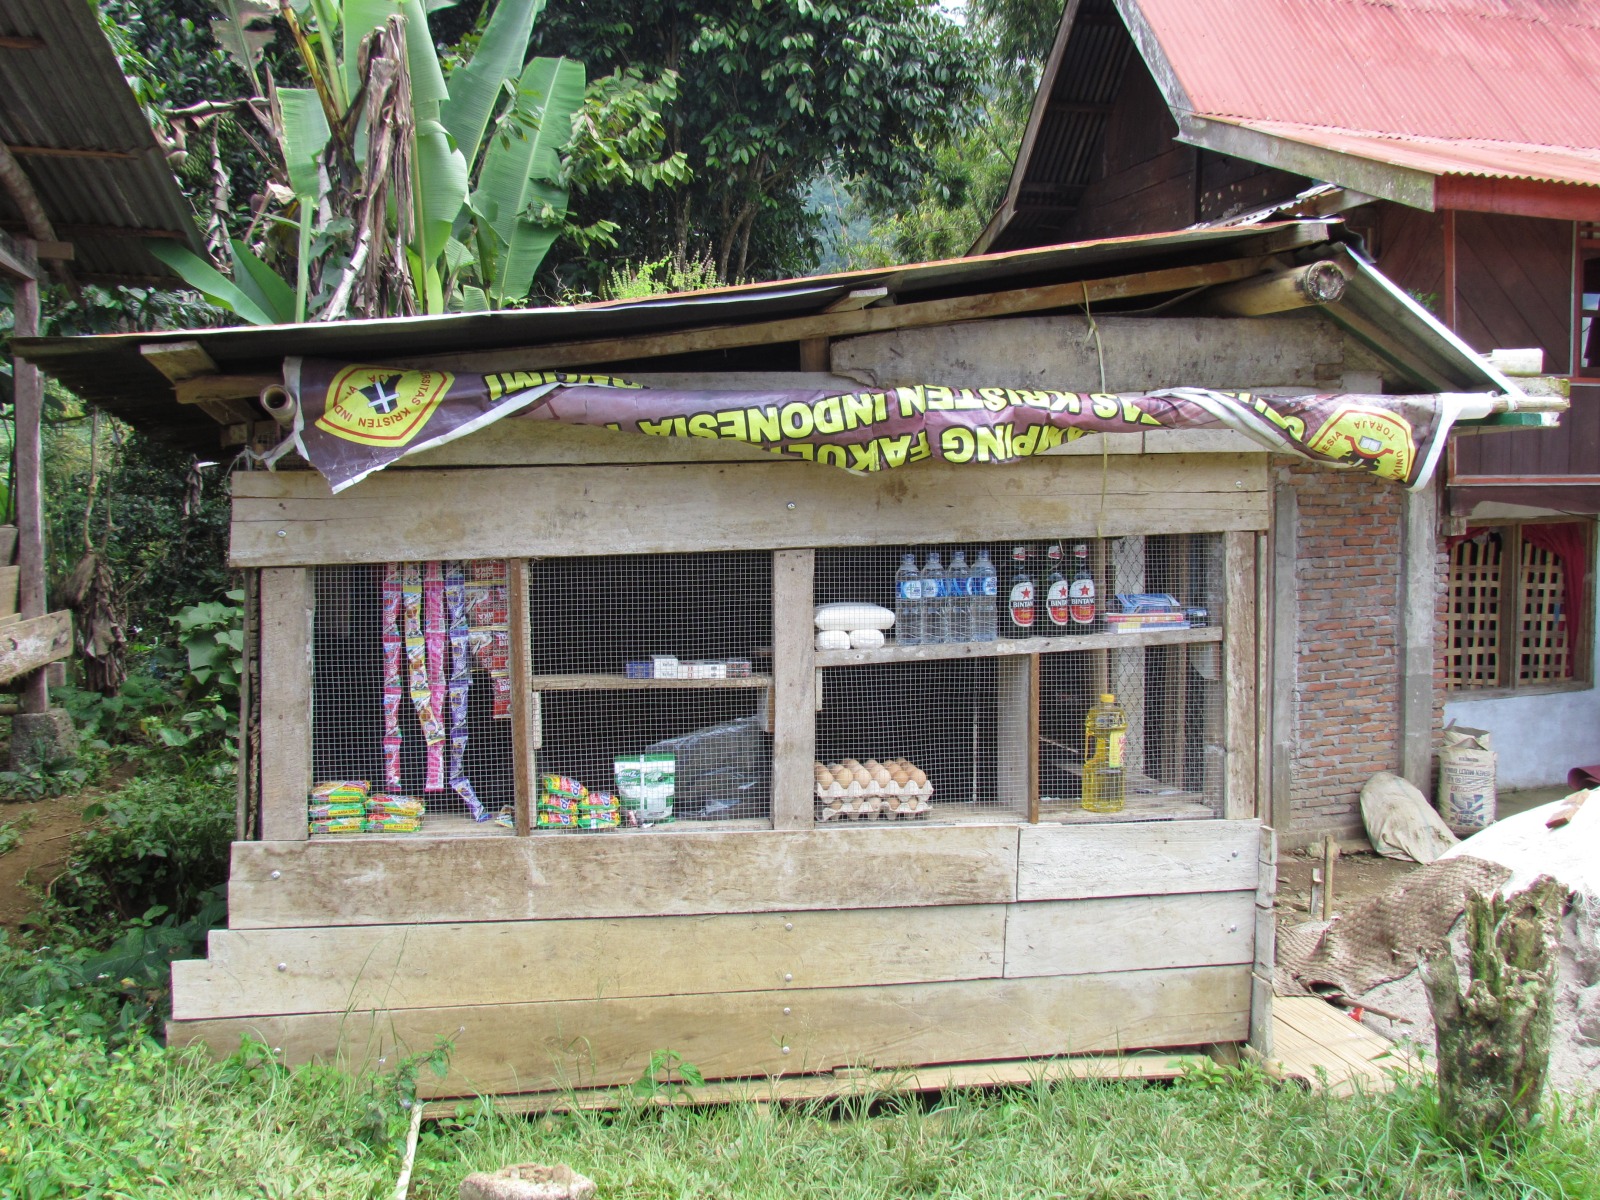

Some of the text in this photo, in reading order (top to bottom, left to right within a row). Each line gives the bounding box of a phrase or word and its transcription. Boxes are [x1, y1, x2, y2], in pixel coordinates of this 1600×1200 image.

[895, 384, 1081, 416] KRISTEN
[357, 407, 411, 428] KRISTEN
[640, 393, 889, 442] INDONESIA
[1353, 420, 1396, 441] TORAJA
[942, 425, 1098, 463] AMPING
[1071, 597, 1095, 605] BINTAN
